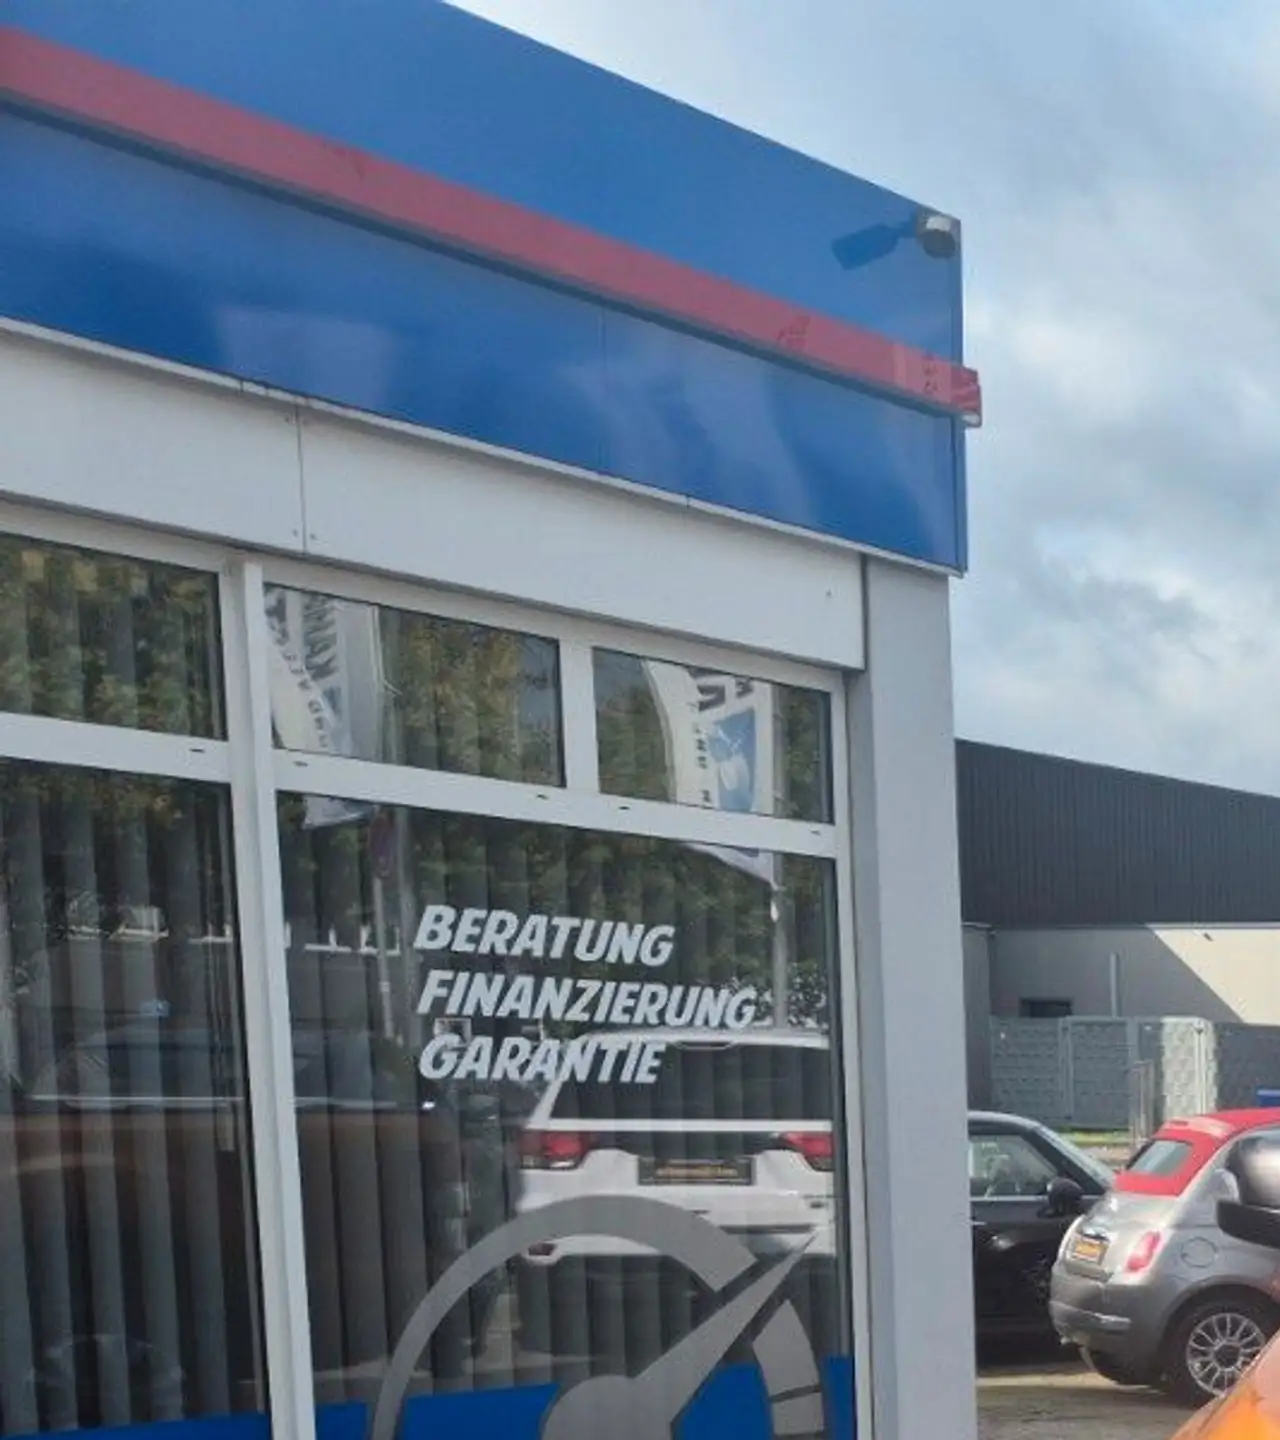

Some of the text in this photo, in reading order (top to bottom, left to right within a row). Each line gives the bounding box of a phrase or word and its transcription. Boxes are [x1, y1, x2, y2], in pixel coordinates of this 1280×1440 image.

[413, 904, 676, 967] BERATUNG
[416, 968, 757, 1029] FINANZIERUNG
[419, 1032, 667, 1084] GARANTIE
